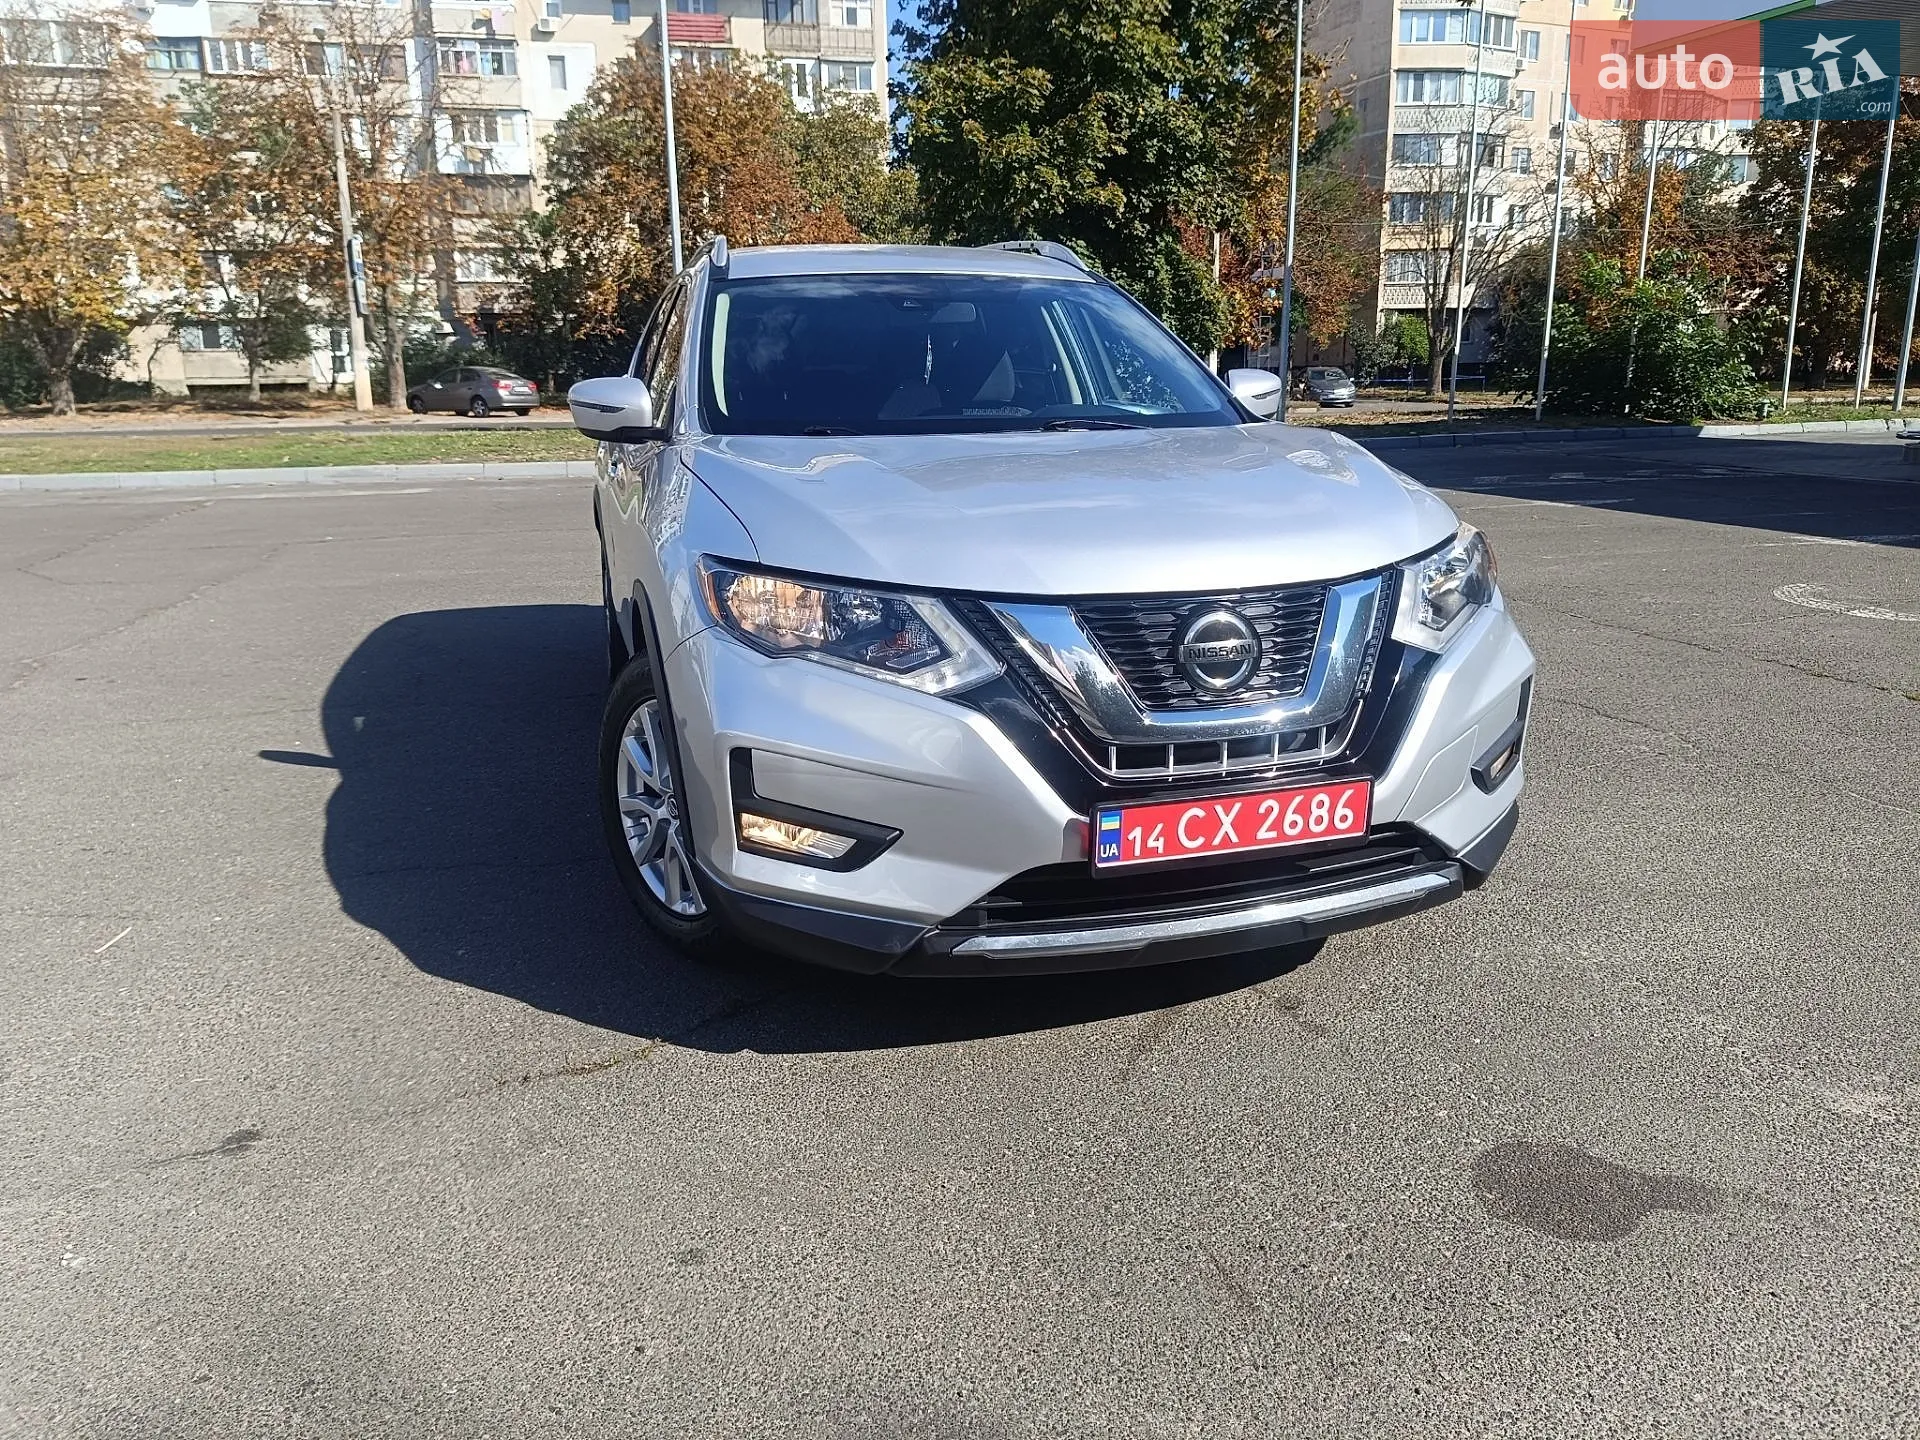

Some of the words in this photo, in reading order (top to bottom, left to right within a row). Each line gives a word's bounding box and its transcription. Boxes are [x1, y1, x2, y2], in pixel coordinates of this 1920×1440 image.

[1188, 643, 1252, 659] NISSAN
[1126, 822, 1164, 857] 14
[1177, 801, 1243, 849] CX
[1255, 788, 1355, 841] 2686
[1100, 841, 1119, 858] UA
